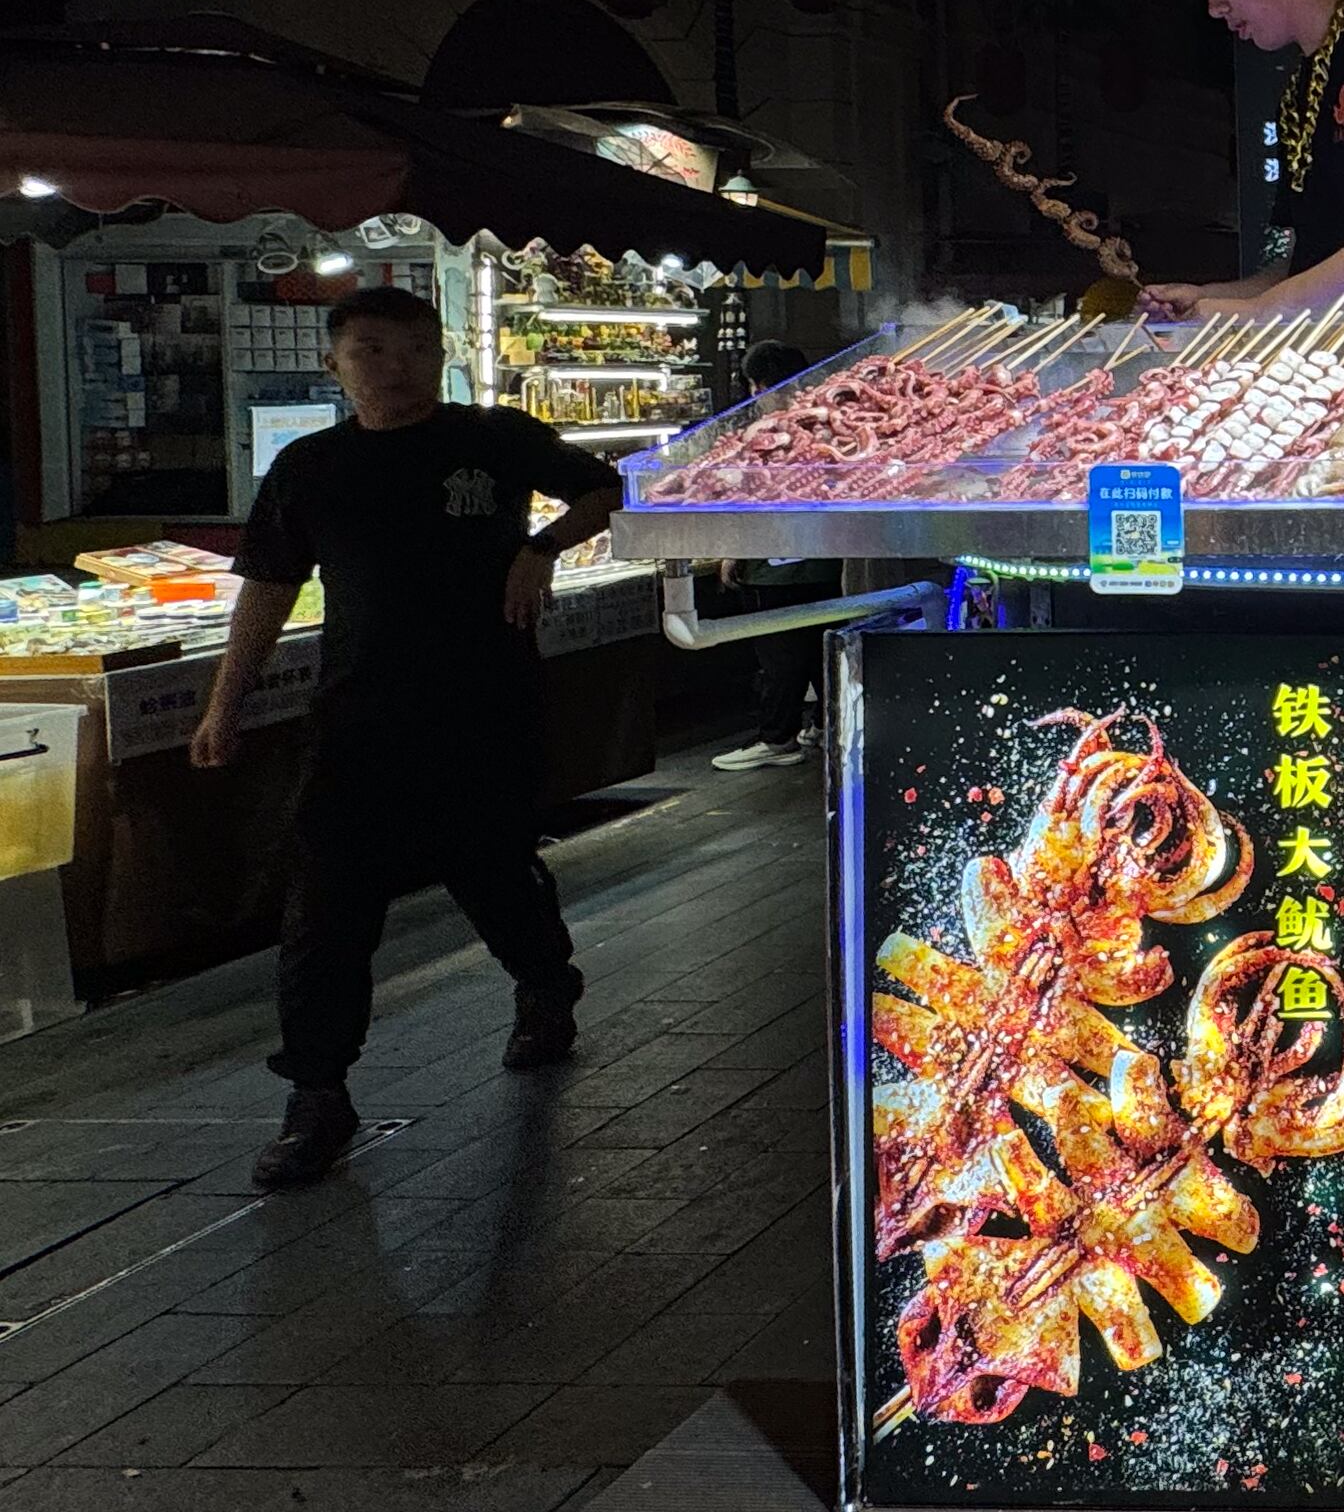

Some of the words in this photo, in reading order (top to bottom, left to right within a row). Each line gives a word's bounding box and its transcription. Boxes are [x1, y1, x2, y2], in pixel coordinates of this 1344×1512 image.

[1272, 683, 1334, 1020] 铁板大鱿鱼
